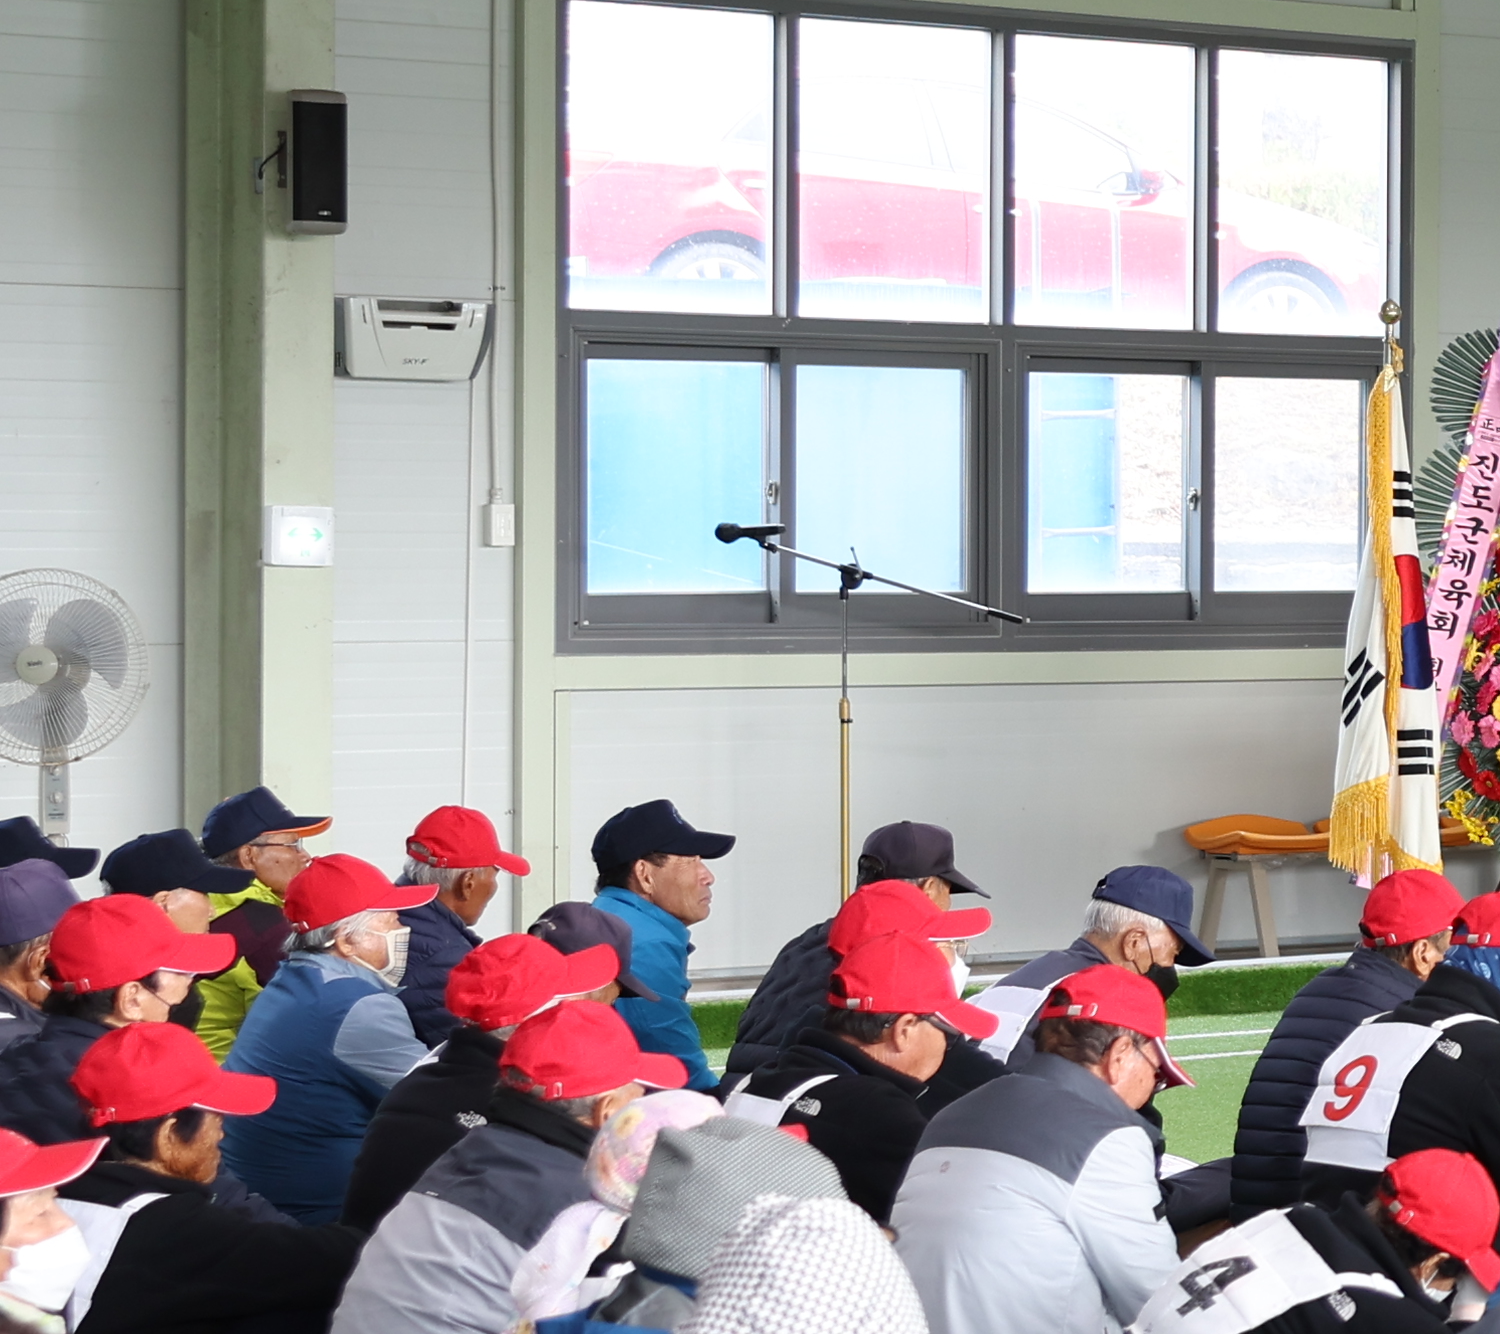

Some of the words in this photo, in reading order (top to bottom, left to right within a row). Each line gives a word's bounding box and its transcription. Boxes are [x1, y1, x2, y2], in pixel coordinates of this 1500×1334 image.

[1428, 452, 1499, 640] 진도군체육회
[1323, 1053, 1378, 1123] 9
[1177, 1255, 1259, 1319] 4
